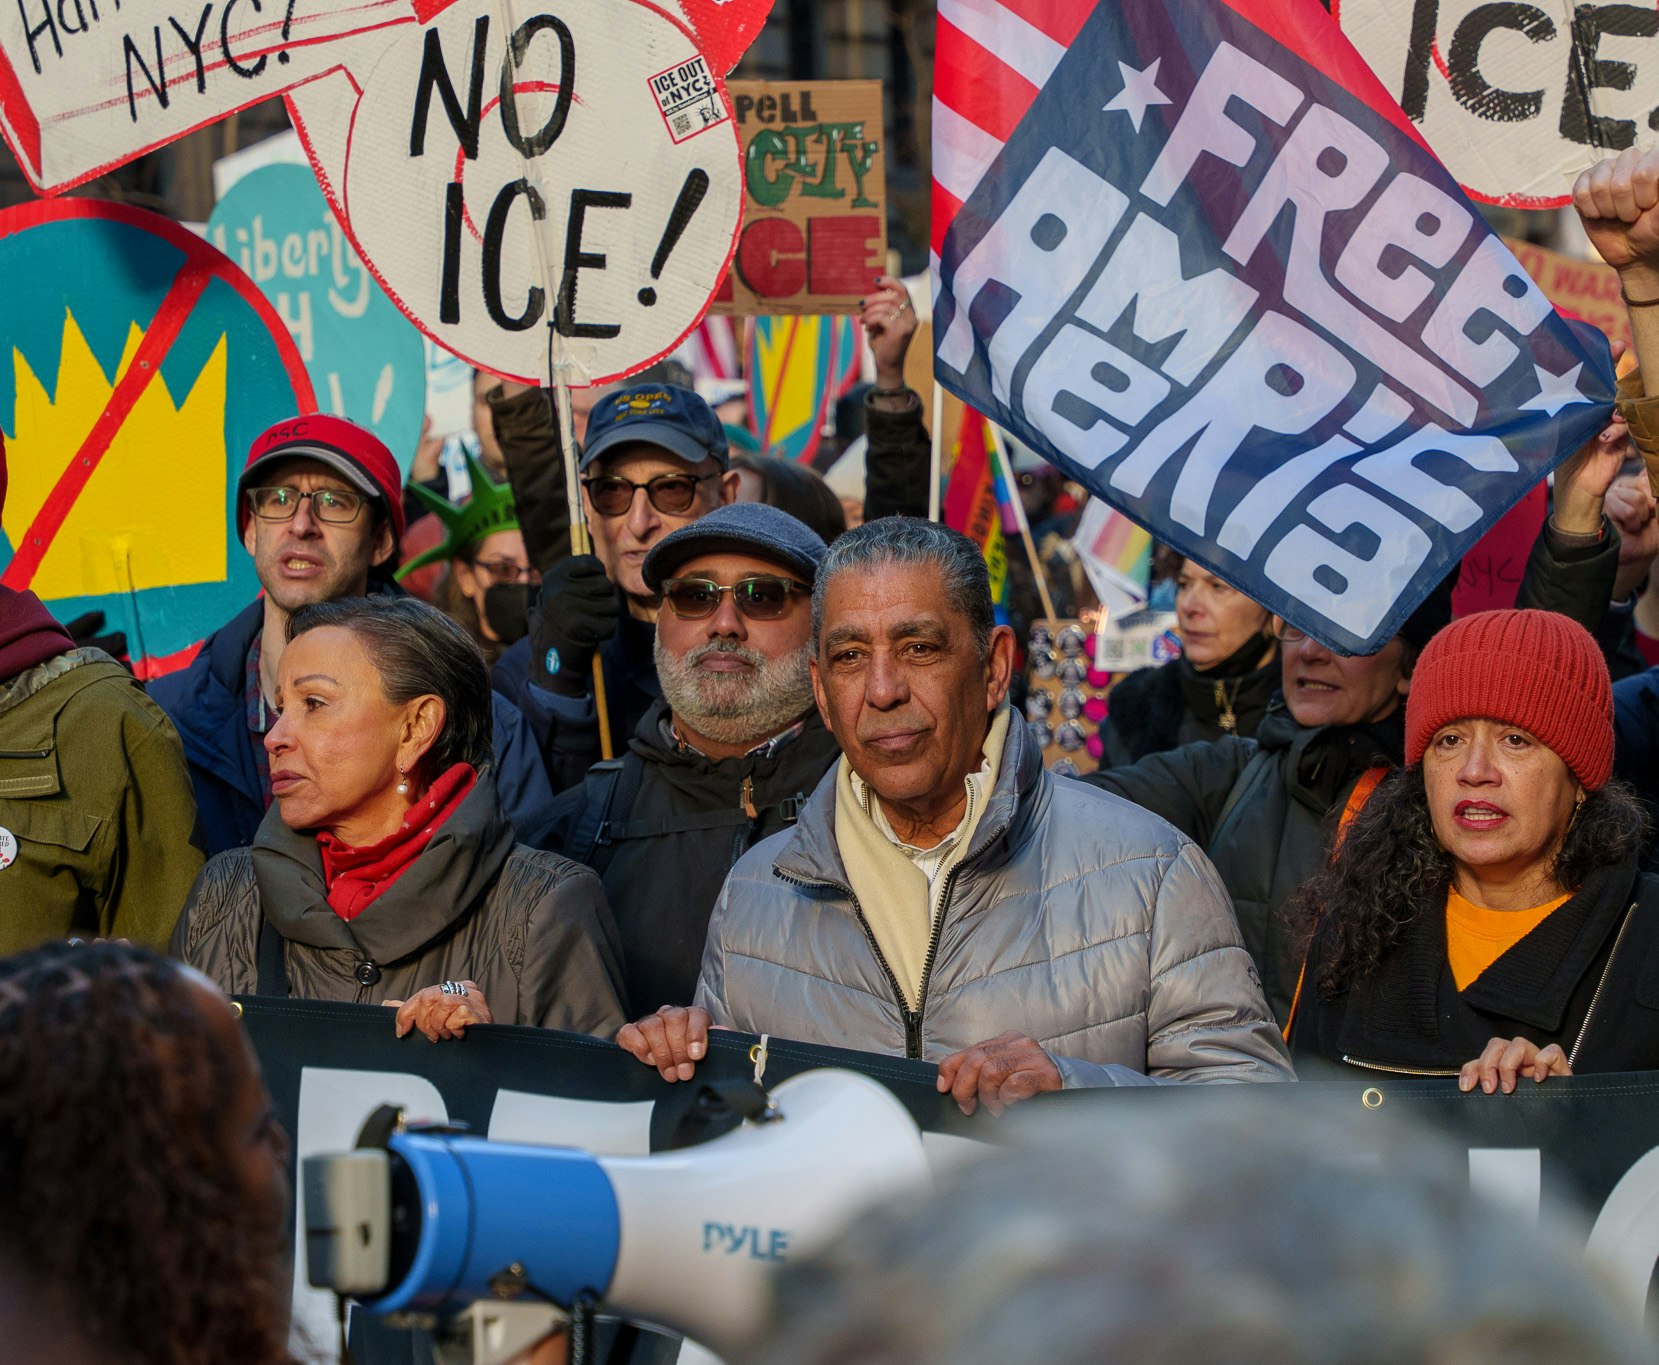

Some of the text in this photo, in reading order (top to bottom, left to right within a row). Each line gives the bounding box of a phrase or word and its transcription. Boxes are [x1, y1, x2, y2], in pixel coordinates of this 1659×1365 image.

[123, 0, 297, 123] NYC!
[410, 14, 576, 160] NO
[654, 58, 704, 94] ICE OUT
[669, 78, 703, 103] NYC
[1400, 0, 1659, 151] ICE
[440, 168, 709, 338] ICE!
[721, 216, 884, 302] CE
[703, 1221, 790, 1263] PYLE
